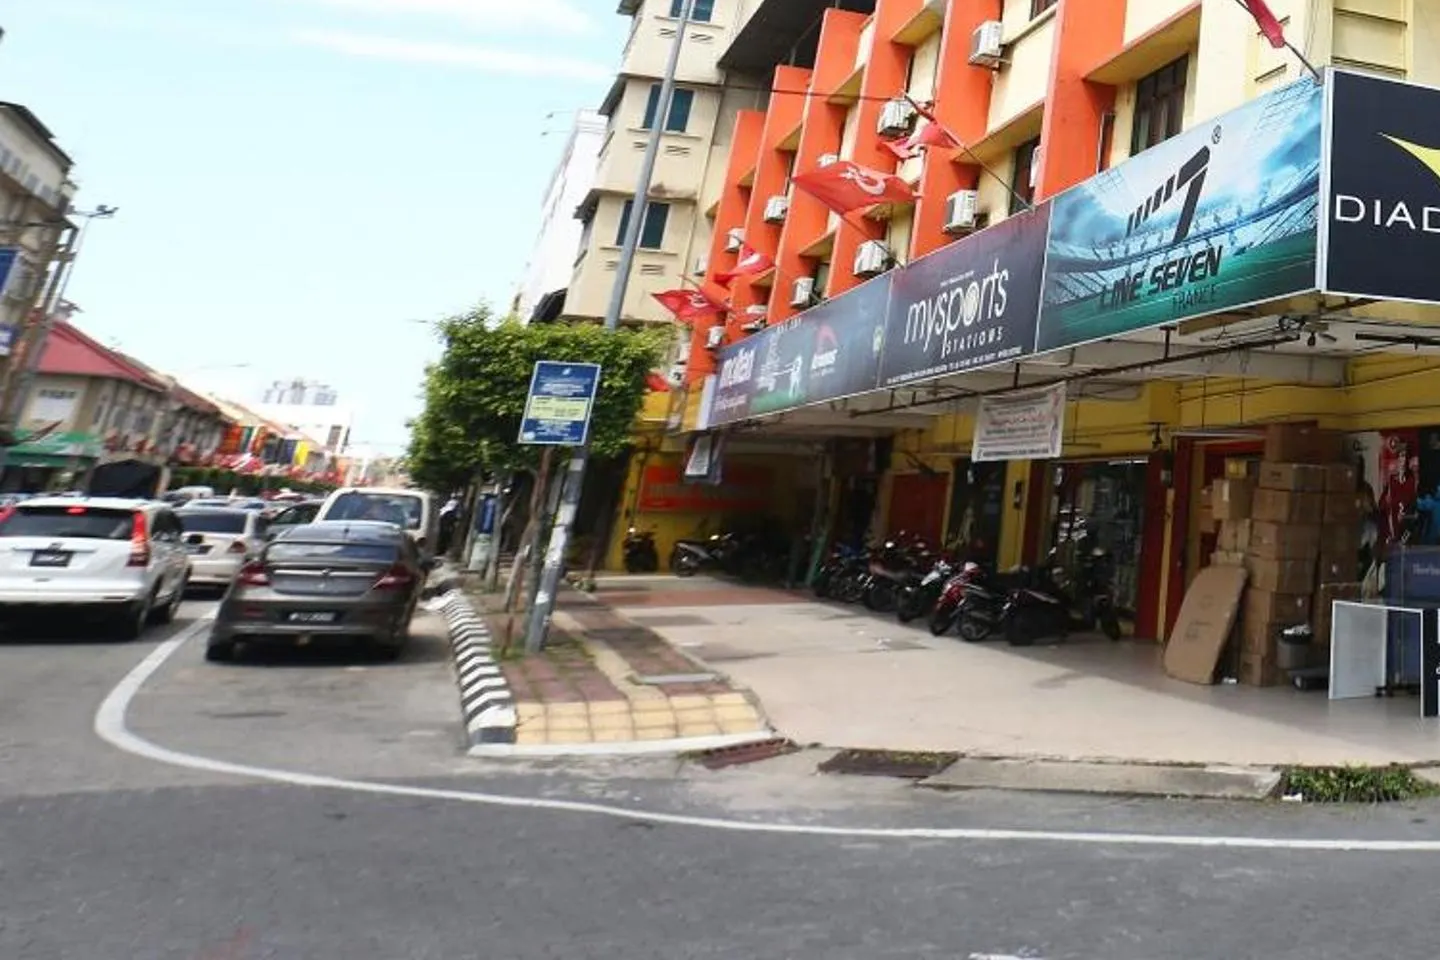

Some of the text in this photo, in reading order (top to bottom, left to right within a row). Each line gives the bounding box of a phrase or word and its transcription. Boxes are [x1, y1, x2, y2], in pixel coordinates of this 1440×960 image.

[1148, 245, 1224, 297] SEVEN
[904, 257, 1009, 359] mysports
[945, 326, 1004, 356] STATIONS
